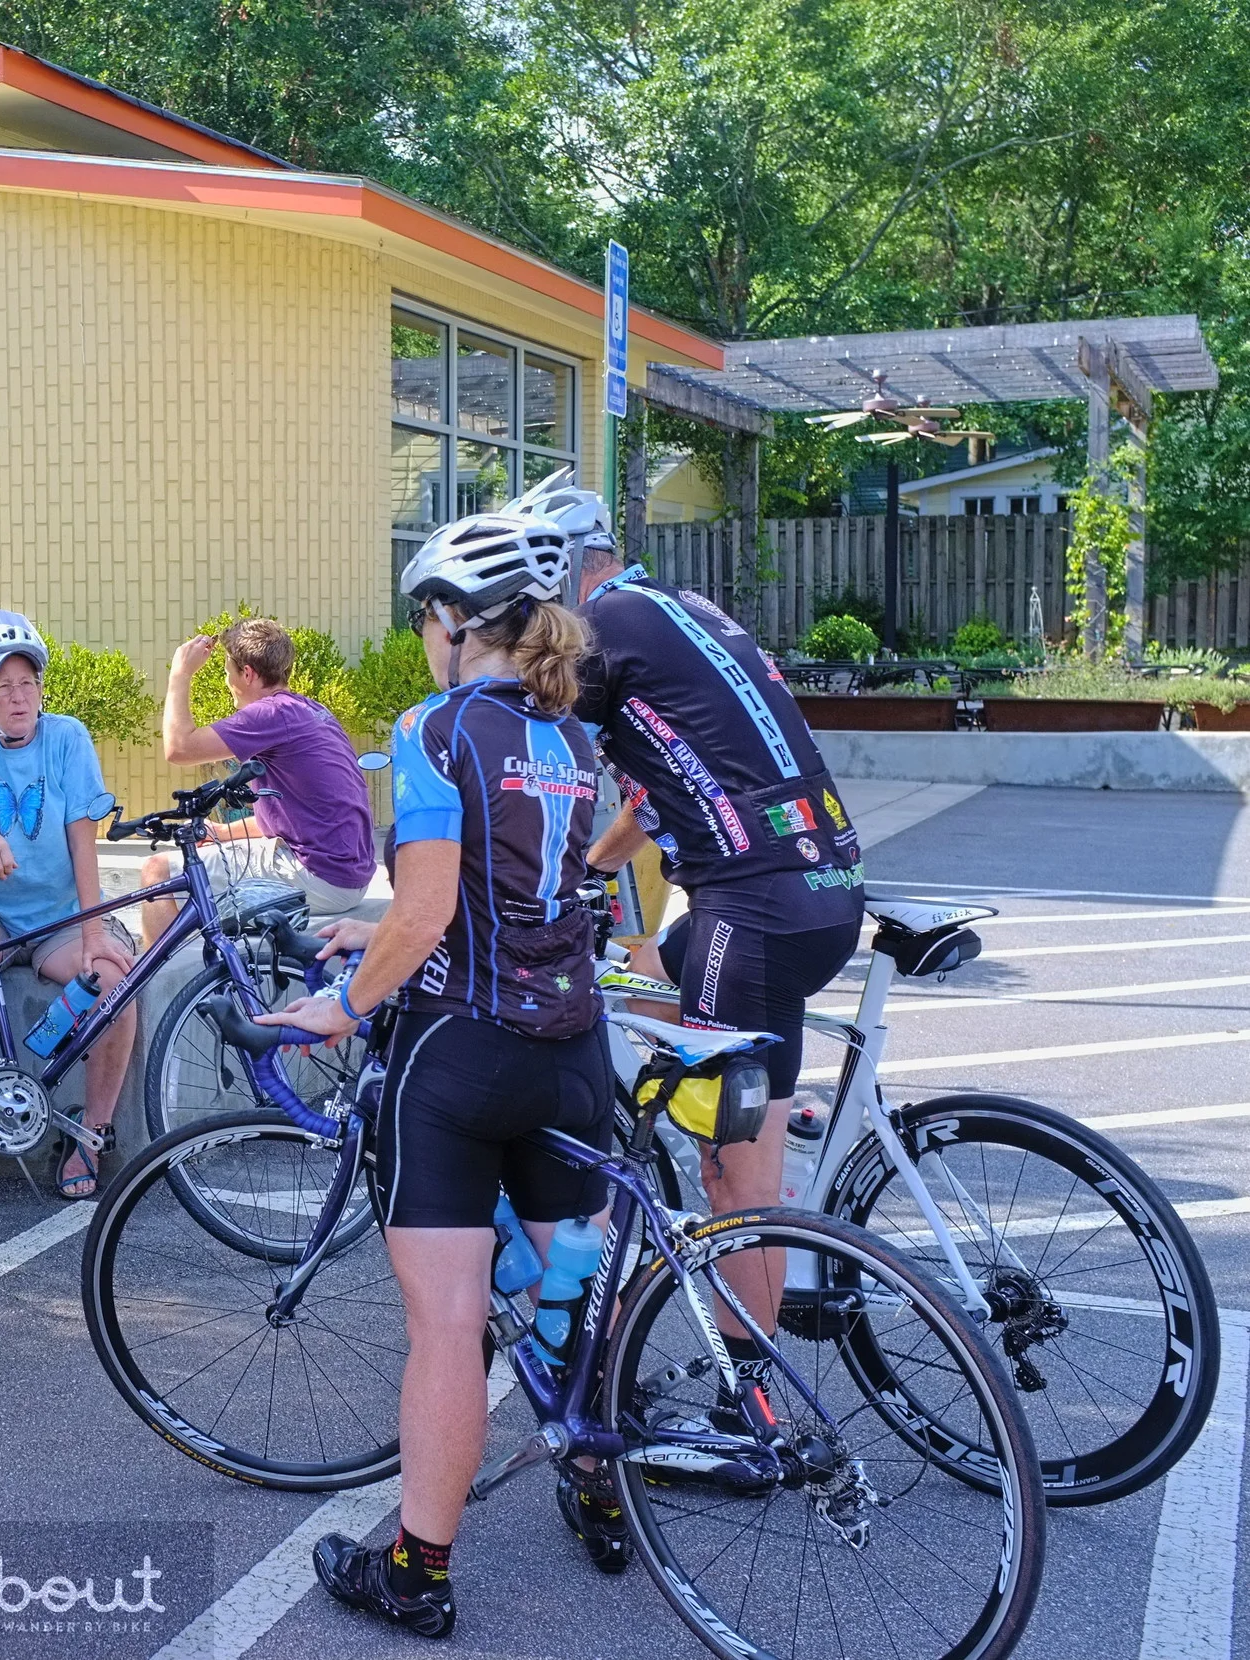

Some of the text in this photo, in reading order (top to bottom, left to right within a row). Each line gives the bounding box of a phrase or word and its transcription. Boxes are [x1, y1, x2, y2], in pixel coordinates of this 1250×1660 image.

[641, 586, 792, 768] SUNSHINE
[503, 756, 554, 777] Cycle
[633, 700, 747, 848] GRAND RENTAL STATION
[694, 795, 731, 857] 706-769-9390
[100, 977, 132, 1015] giant
[699, 920, 733, 1016] BRIDGESTONE
[168, 1131, 261, 1169] ZIPP
[835, 1159, 854, 1191] GIANT
[584, 1221, 619, 1340] SPECIALIZED
